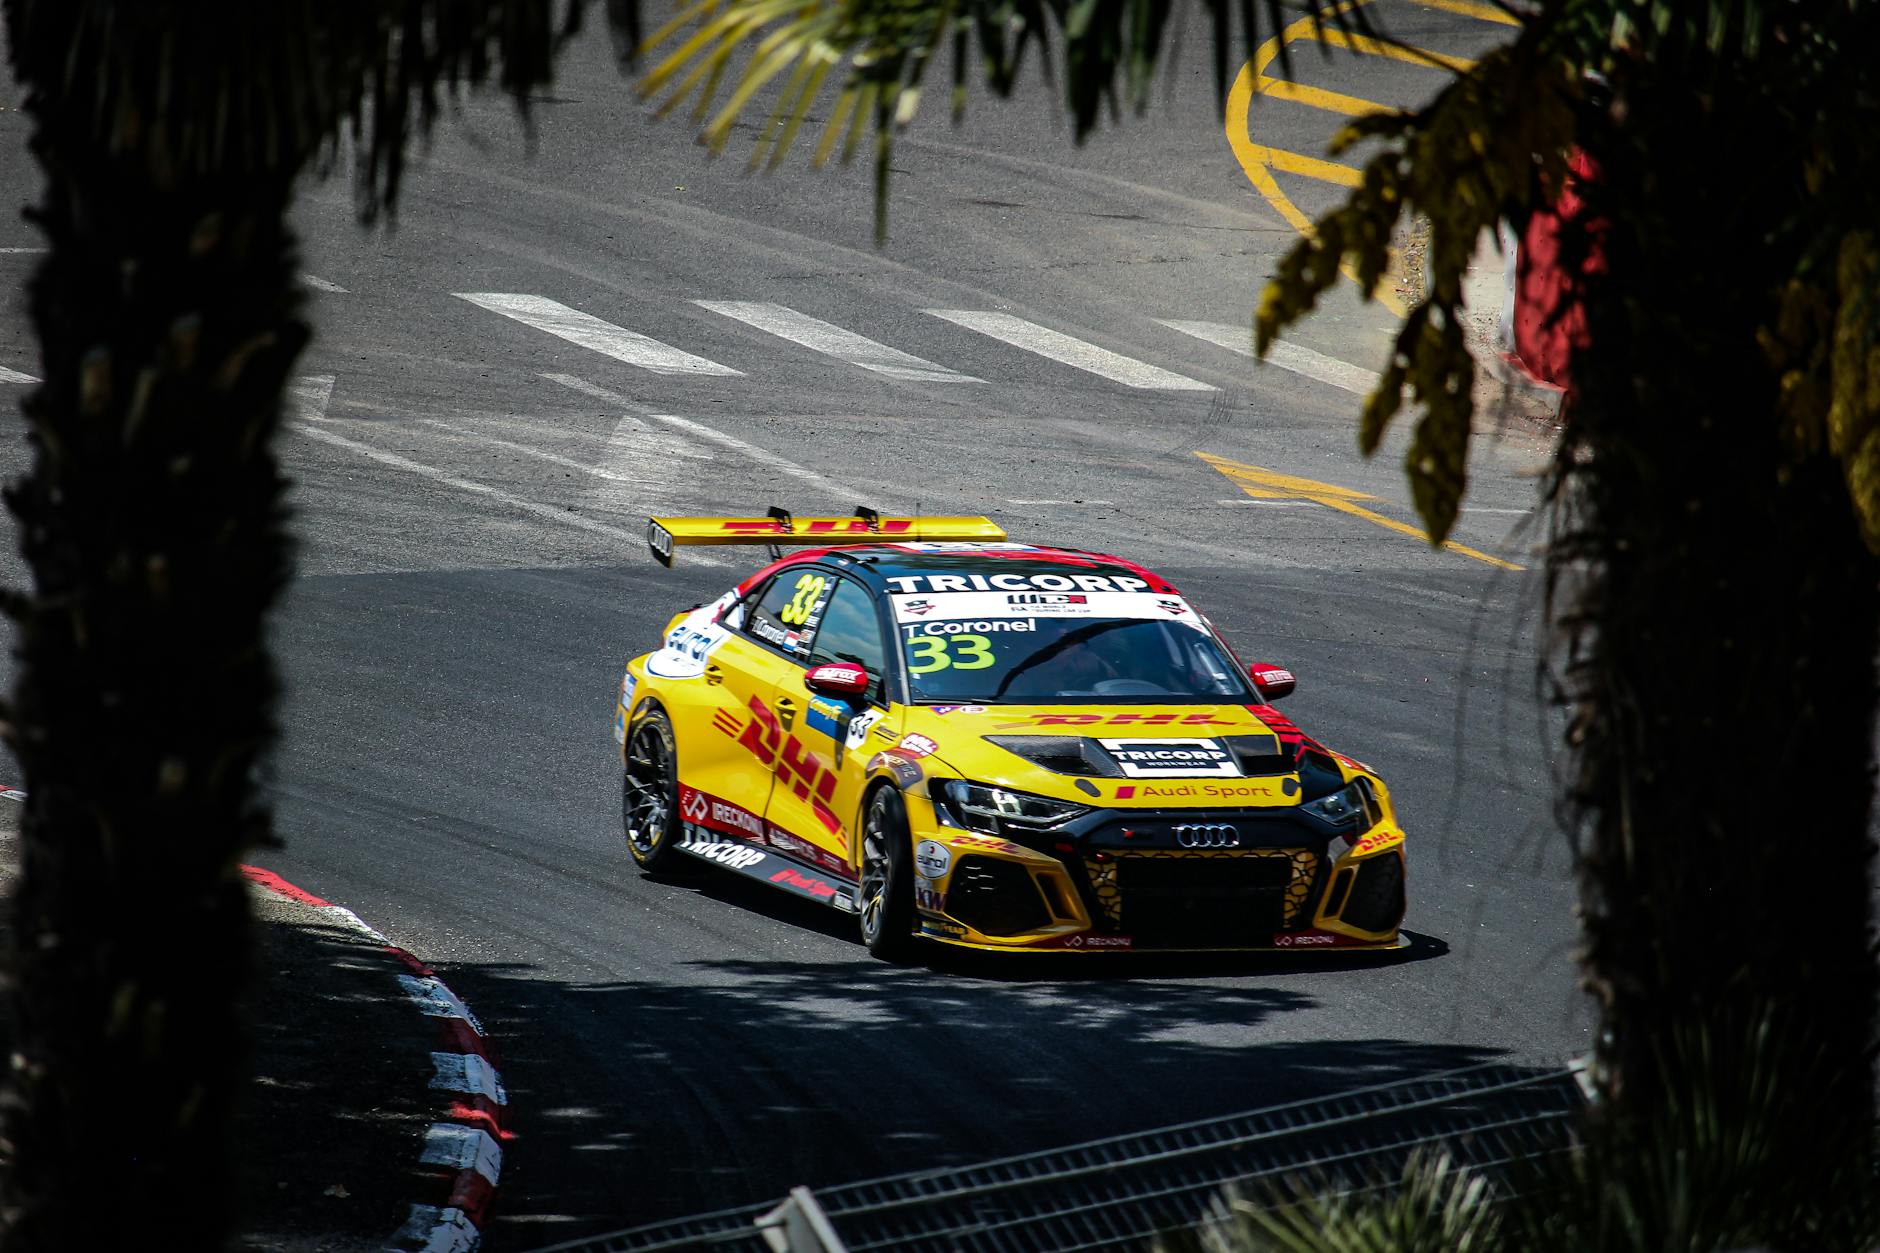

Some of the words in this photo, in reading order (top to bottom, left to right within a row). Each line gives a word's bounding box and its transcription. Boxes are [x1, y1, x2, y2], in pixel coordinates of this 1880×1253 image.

[886, 574, 1149, 593] TRICORP
[781, 573, 825, 625] 33
[907, 634, 996, 674] 33
[850, 713, 873, 739] 33
[1030, 714, 1237, 726] DHL
[1110, 750, 1227, 760] TRICORP
[738, 694, 842, 836] DHL
[1142, 786, 1197, 797] Audi
[1203, 785, 1273, 799] Sport
[951, 836, 1019, 854] DHL
[1358, 831, 1398, 851] DHL
[917, 854, 947, 869] eurol
